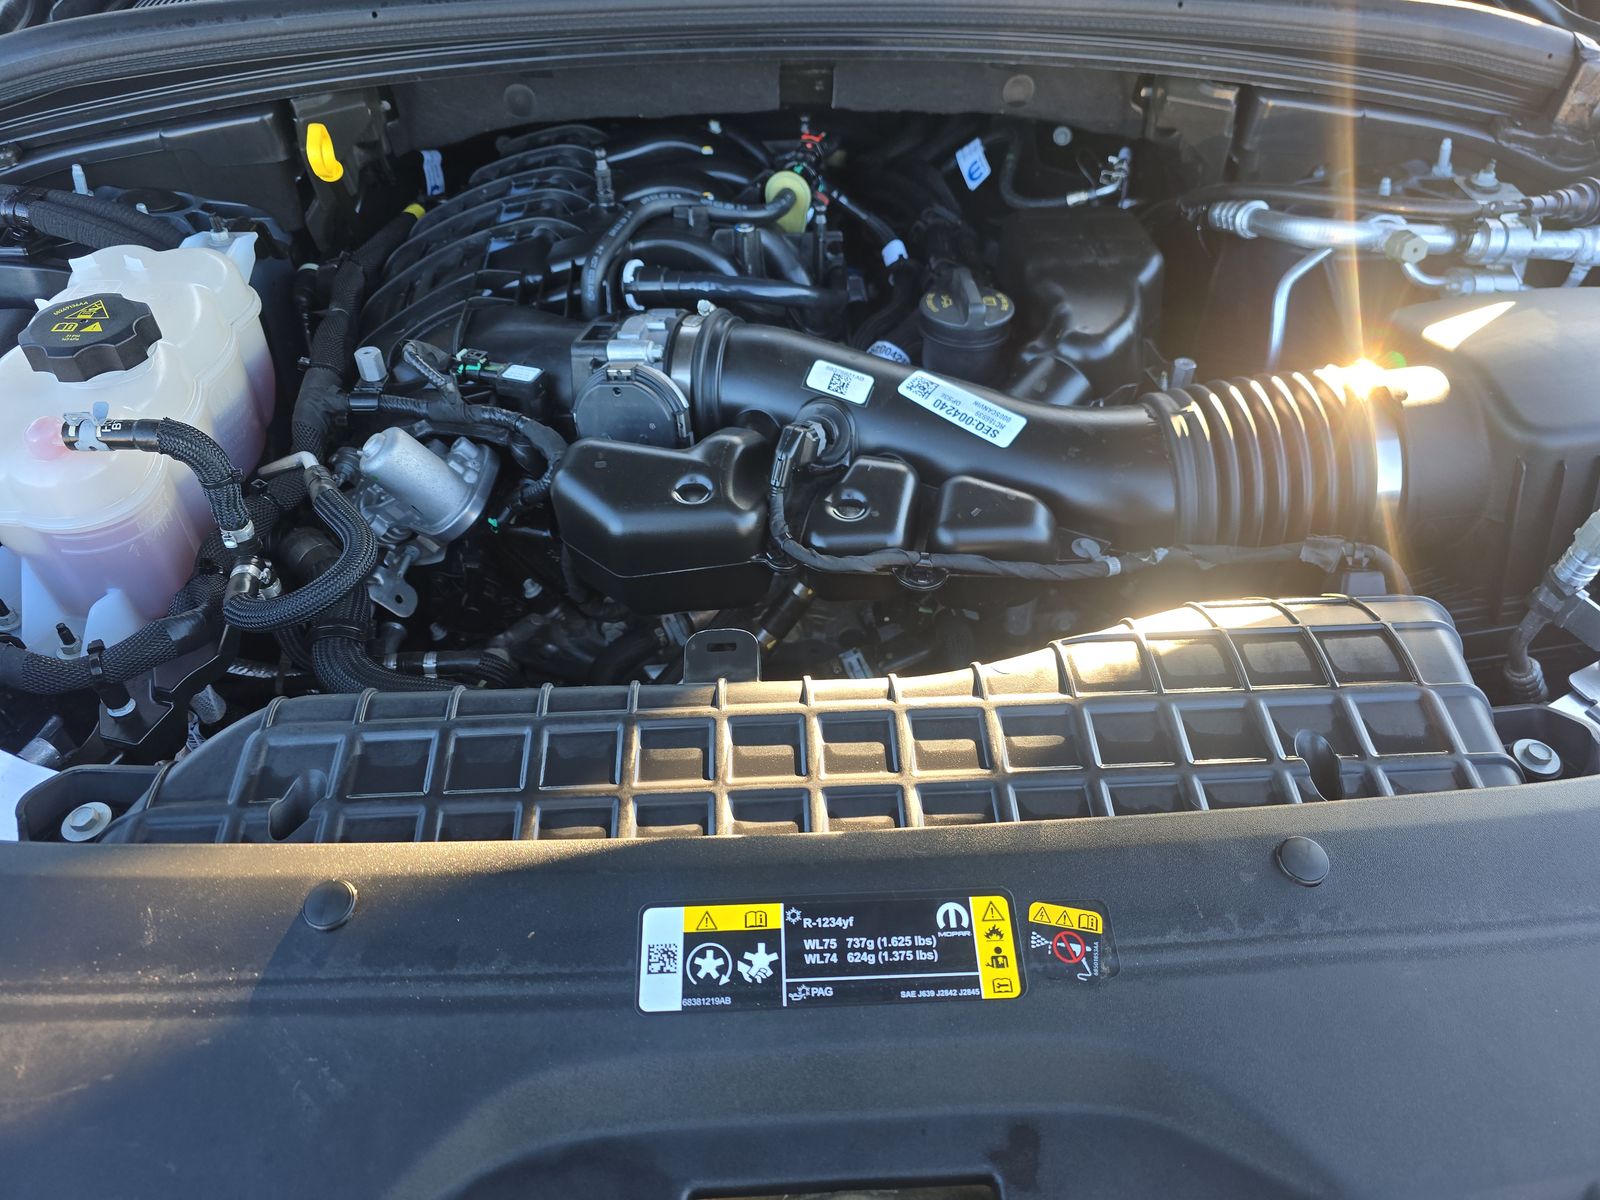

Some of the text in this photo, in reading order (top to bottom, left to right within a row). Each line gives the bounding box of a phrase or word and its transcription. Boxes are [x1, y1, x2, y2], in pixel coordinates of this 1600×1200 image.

[933, 399, 1000, 438] SEQ:004240
[803, 916, 854, 929] R-1234yf
[804, 935, 937, 950] WL75 737g (1.625 lbs)
[804, 950, 938, 964] WL74 624g (1.375 lbs)
[811, 987, 833, 996] PAG
[900, 988, 981, 998] SAE J639 J2842 J2845
[682, 996, 732, 1007] 68381219AB
